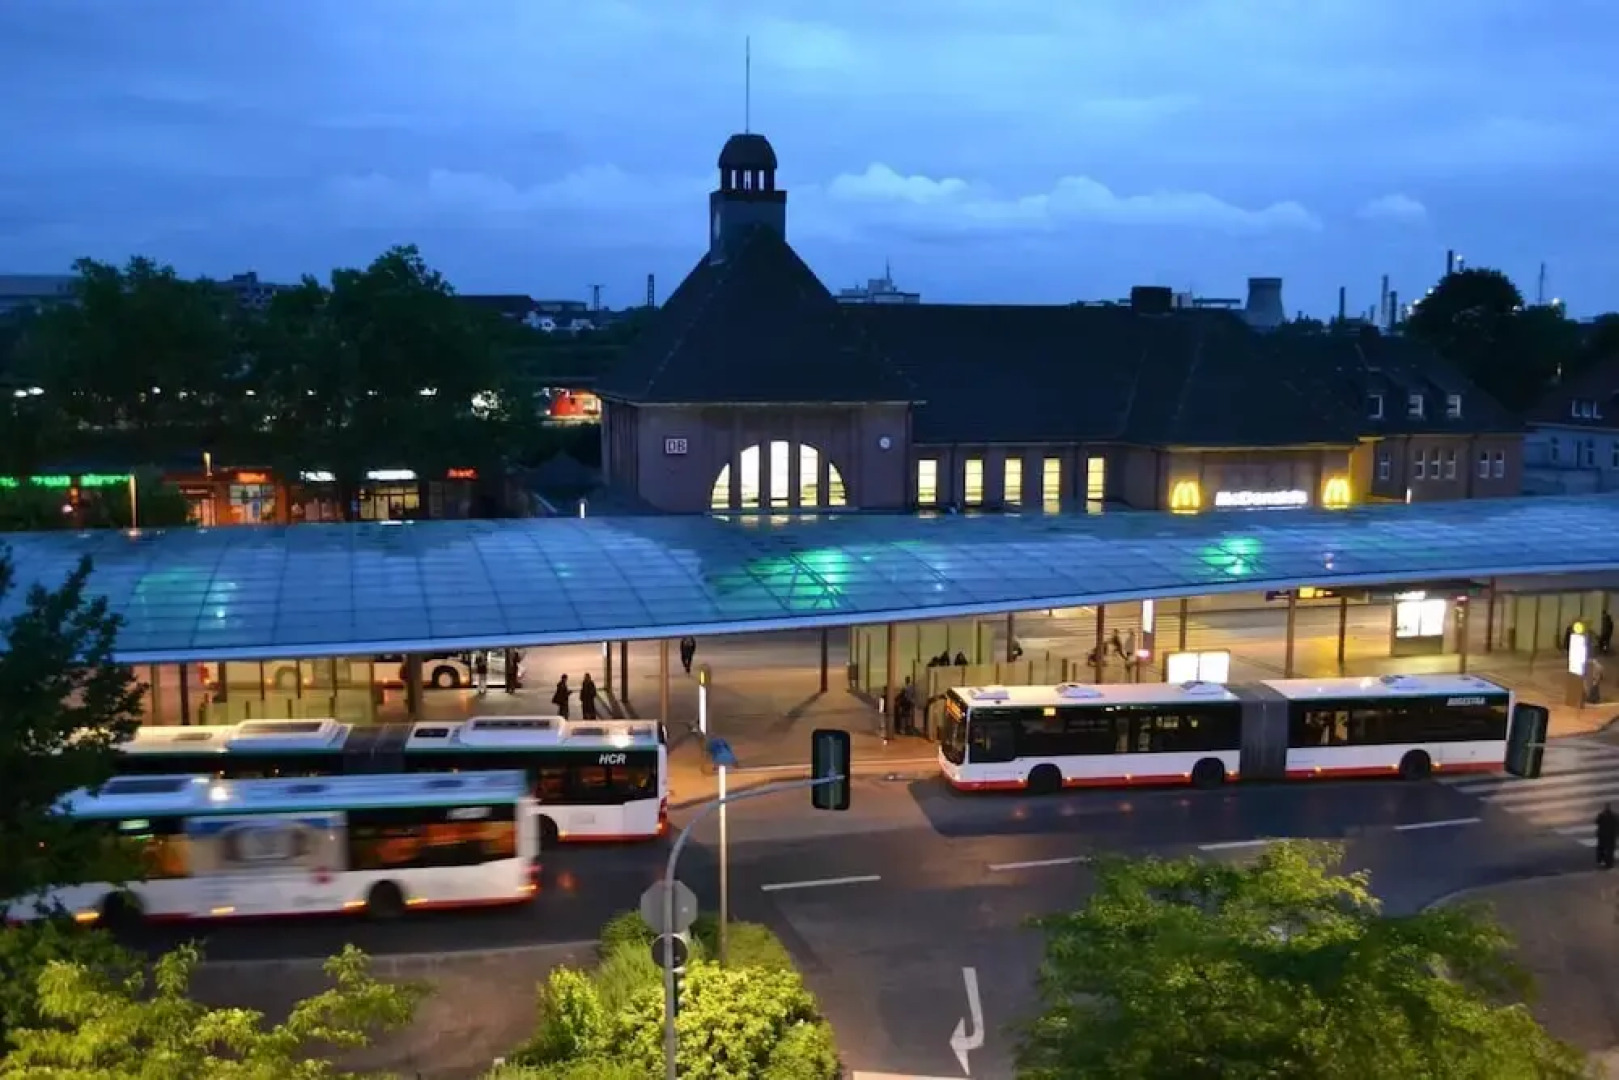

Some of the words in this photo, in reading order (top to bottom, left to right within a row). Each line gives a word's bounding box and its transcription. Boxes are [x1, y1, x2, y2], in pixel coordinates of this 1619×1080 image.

[668, 440, 686, 452] DB
[1215, 490, 1308, 505] McDon
[598, 752, 626, 765] HCR
